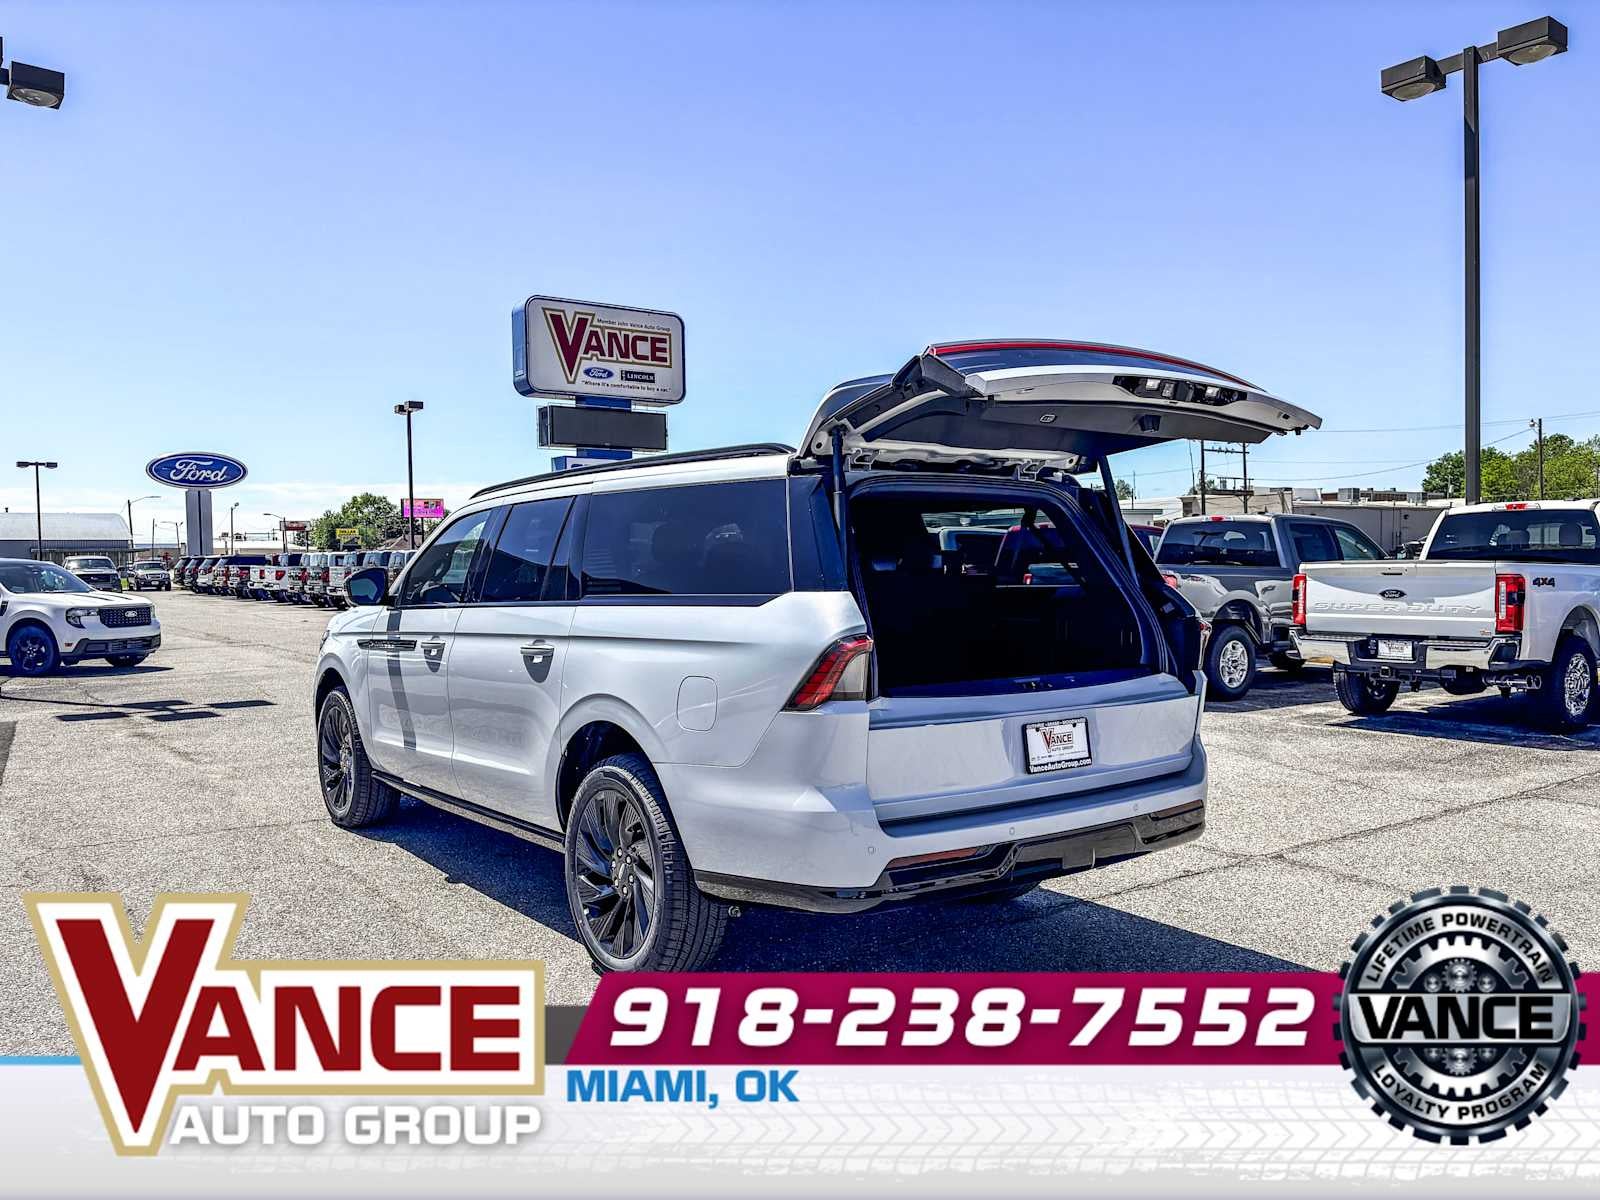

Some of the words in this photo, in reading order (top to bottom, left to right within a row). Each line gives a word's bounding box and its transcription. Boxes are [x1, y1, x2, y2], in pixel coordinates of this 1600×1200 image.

[549, 313, 668, 378] VANCE
[589, 368, 608, 378] Ford
[627, 372, 655, 381] LINCOLN
[169, 459, 228, 481] Ford
[1314, 601, 1400, 612] SUPER
[1408, 602, 1481, 614] DUTY
[1042, 730, 1072, 749] VANCE
[1029, 758, 1092, 773] VanceAutoGroup.com
